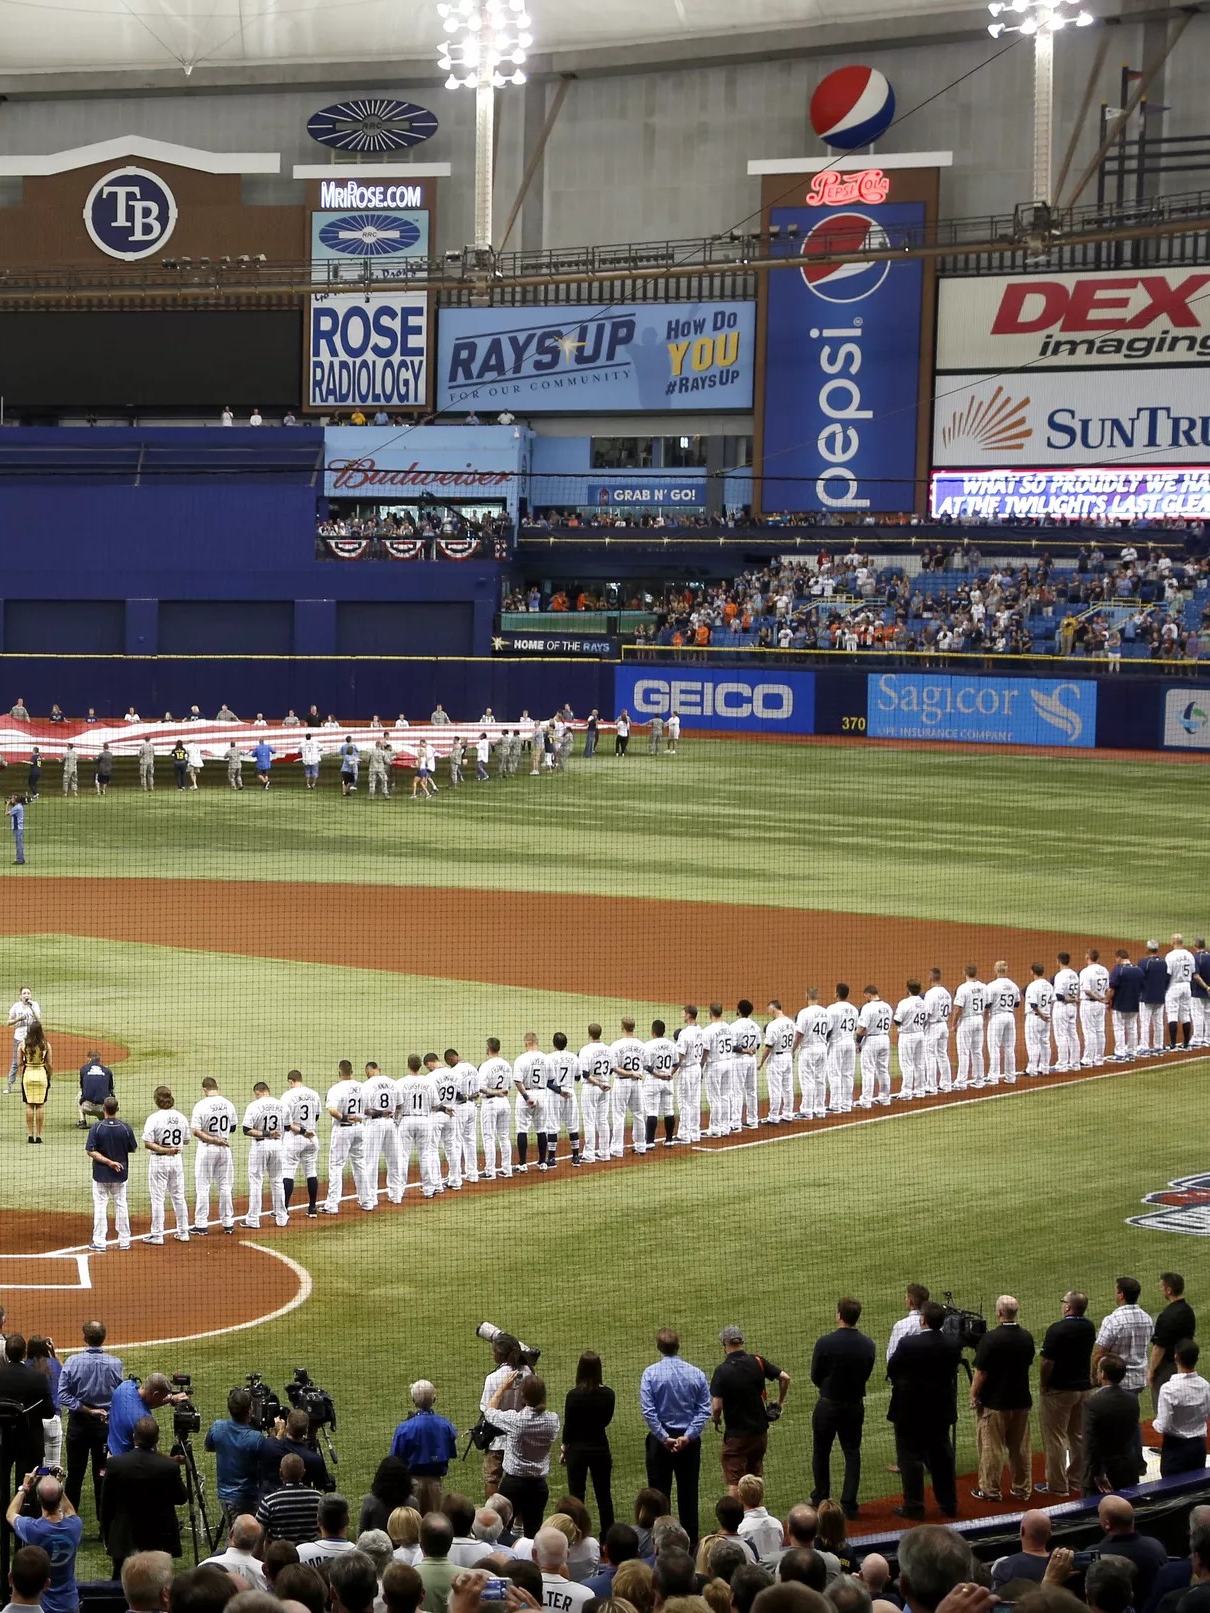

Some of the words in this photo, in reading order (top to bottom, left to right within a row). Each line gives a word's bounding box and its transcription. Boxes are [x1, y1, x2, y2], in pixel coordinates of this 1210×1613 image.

[102, 186, 162, 241] TB
[991, 274, 1210, 335] DEX
[312, 305, 424, 359] ROSE
[448, 329, 564, 383] RAYS
[574, 319, 636, 365] UP
[667, 332, 740, 376] YOU
[312, 359, 423, 404] RADIOLOGY
[449, 390, 480, 402] FOR
[489, 384, 522, 397] OUR
[530, 369, 632, 392] COMMUNITY
[809, 328, 873, 508] pepsi
[328, 458, 514, 489] Budweiser
[963, 475, 1019, 495] WHAT
[1019, 475, 1047, 494] SO
[1050, 475, 1142, 493] PROUDLY
[1146, 474, 1179, 492] WE
[614, 488, 651, 501] GRAB
[671, 488, 696, 501] GO!
[938, 496, 967, 514] AT
[1111, 494, 1162, 513] LAST
[514, 640, 544, 650] HOME
[547, 641, 560, 650] OF
[563, 641, 581, 651] THE
[583, 642, 610, 652] RAYS
[633, 679, 793, 719] GEICO
[878, 673, 1020, 724] Sagicor
[842, 717, 866, 731] 370
[901, 728, 958, 738] INSURANCE
[1000, 994, 1014, 1007] 53
[813, 1021, 827, 1036] 40
[841, 1018, 855, 1032] 43
[719, 1038, 732, 1054] 35
[741, 1034, 756, 1049] 37
[593, 1060, 609, 1076] 23
[623, 1056, 640, 1071] 26
[656, 1054, 672, 1070] 30
[532, 1068, 541, 1084] 5
[559, 1066, 568, 1083] 7
[380, 1092, 389, 1109] 8
[413, 1093, 422, 1110] 11
[440, 1085, 455, 1102] 39
[300, 1104, 309, 1121] 3
[347, 1098, 361, 1115] 21
[209, 1115, 228, 1133] 20
[263, 1115, 278, 1132] 13
[162, 1128, 182, 1146] 28
